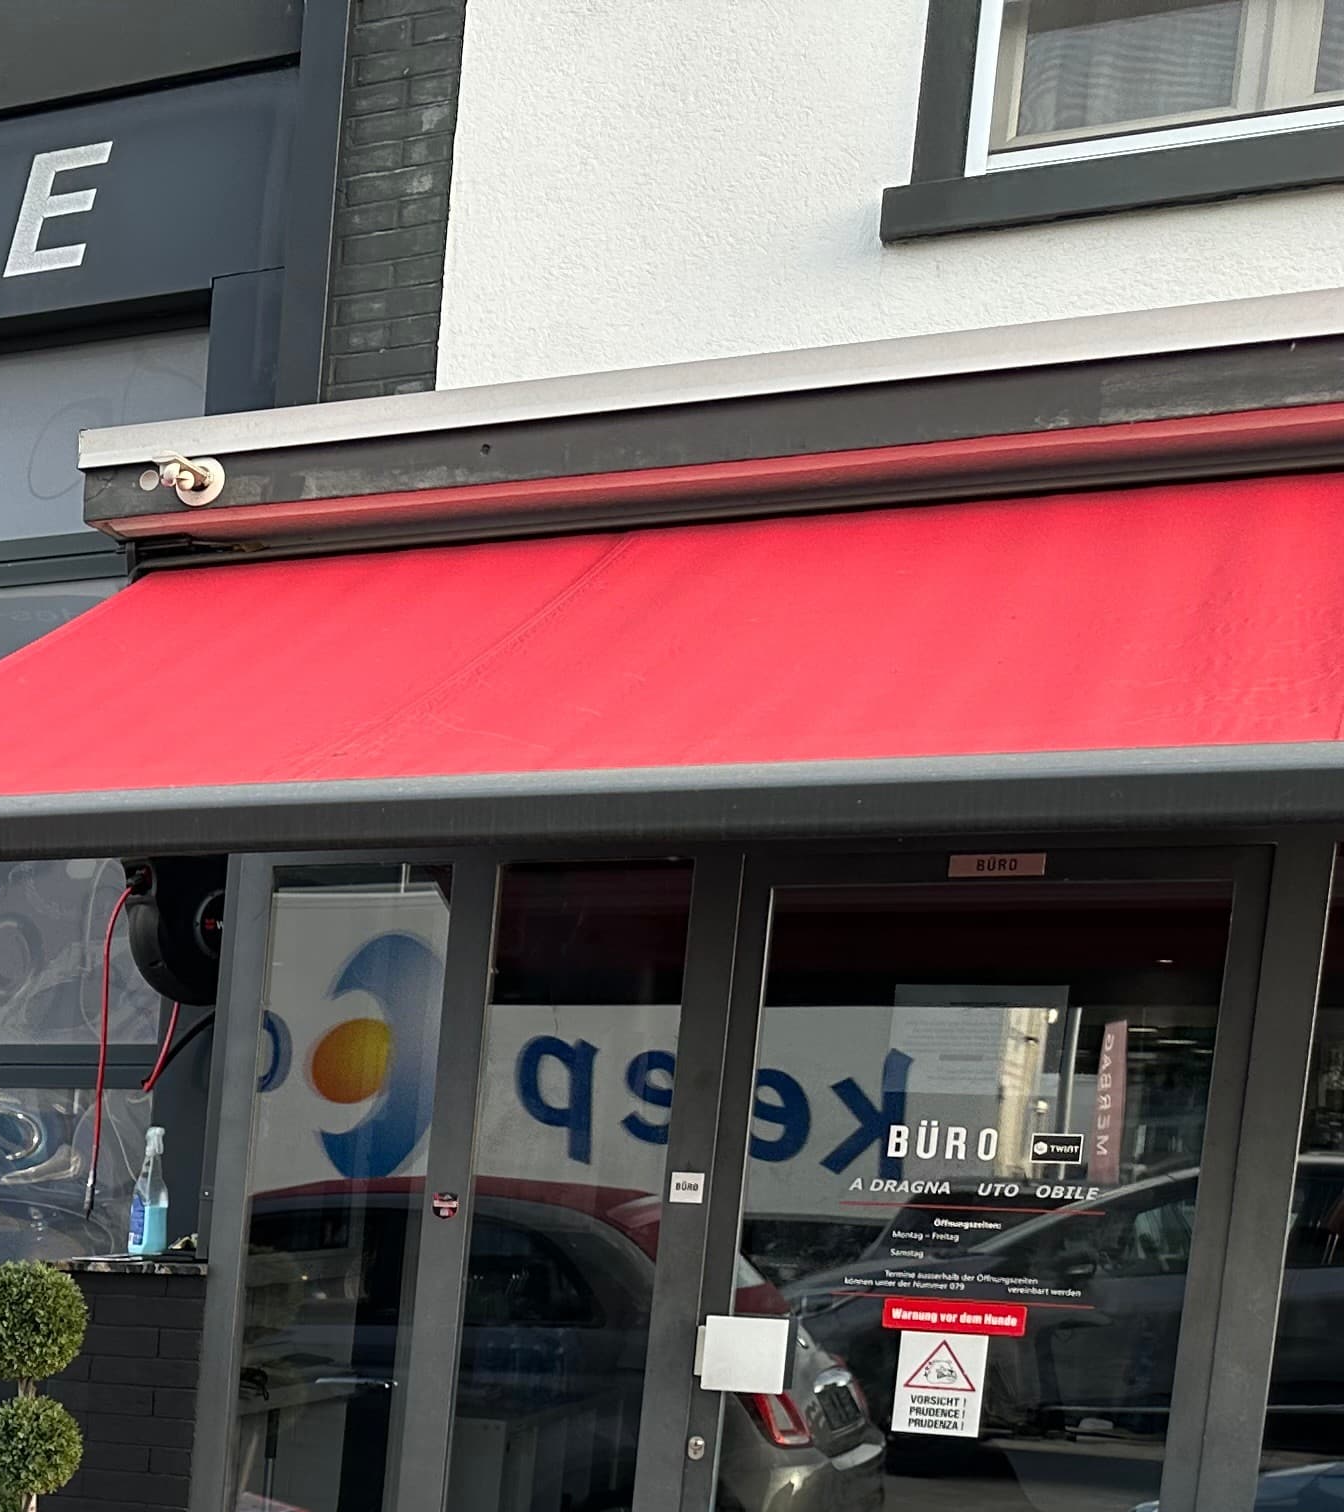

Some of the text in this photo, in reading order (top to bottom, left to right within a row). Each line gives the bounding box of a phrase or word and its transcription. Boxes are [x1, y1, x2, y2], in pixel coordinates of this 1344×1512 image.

[976, 857, 1018, 872] BÜRO
[887, 1120, 998, 1161] BÜRO
[675, 1181, 699, 1191] BÜRO
[892, 1230, 923, 1240] Montag
[932, 1232, 959, 1242] Freitag
[890, 1248, 924, 1259] Samstag
[885, 1270, 915, 1279] Termine
[949, 1282, 965, 1290] 079
[892, 1308, 1017, 1327] Warnung vor dem Hunde
[910, 1394, 960, 1406] VORSICHT
[909, 1406, 960, 1419] PRUDENCE
[908, 1418, 958, 1430] PRUDENZA
